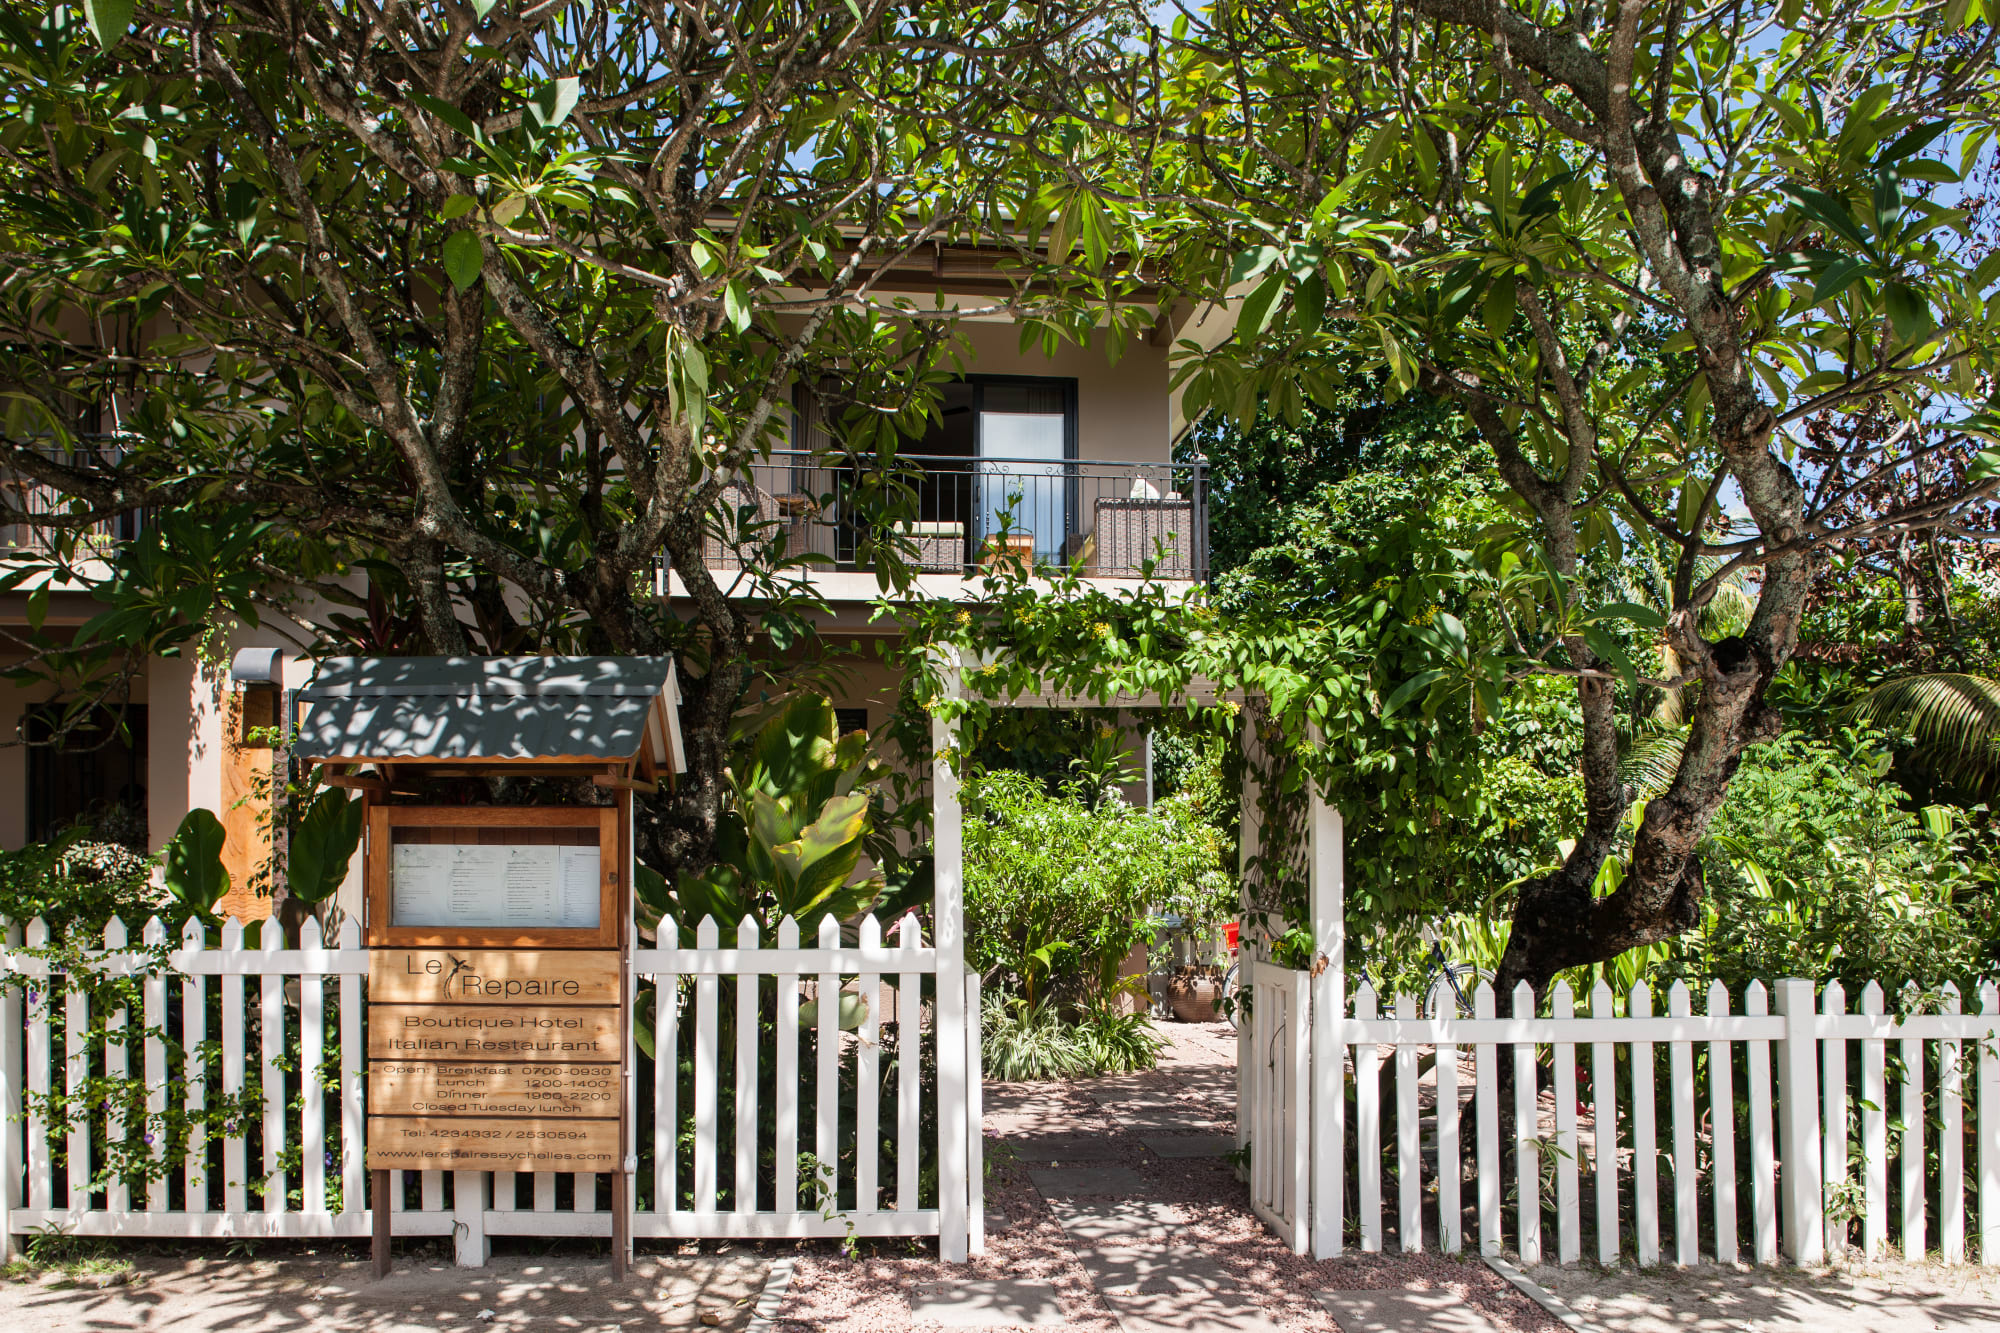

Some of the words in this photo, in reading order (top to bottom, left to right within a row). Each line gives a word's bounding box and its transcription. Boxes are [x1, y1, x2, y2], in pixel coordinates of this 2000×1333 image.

[407, 955, 442, 975] Le
[462, 975, 580, 999] Repaire
[405, 1016, 514, 1028] Boutique
[521, 1017, 583, 1028] Hotel
[388, 1039, 458, 1050] Italian
[465, 1039, 599, 1051] Restaurant
[384, 1066, 430, 1074] Open:
[437, 1066, 512, 1075] Breakfast
[522, 1067, 611, 1075] 0700-0930
[437, 1079, 485, 1087] Lunch
[437, 1090, 487, 1099] Dinner
[525, 1092, 611, 1100] 1900-2200
[412, 1103, 466, 1111] Closed
[470, 1103, 535, 1113] Tuesday
[539, 1104, 582, 1112] lunch
[401, 1129, 425, 1137] Tel:
[430, 1130, 501, 1138] 4234332
[516, 1131, 587, 1139] 2530594
[377, 1150, 611, 1161] www.lerepaireseychelles.com
